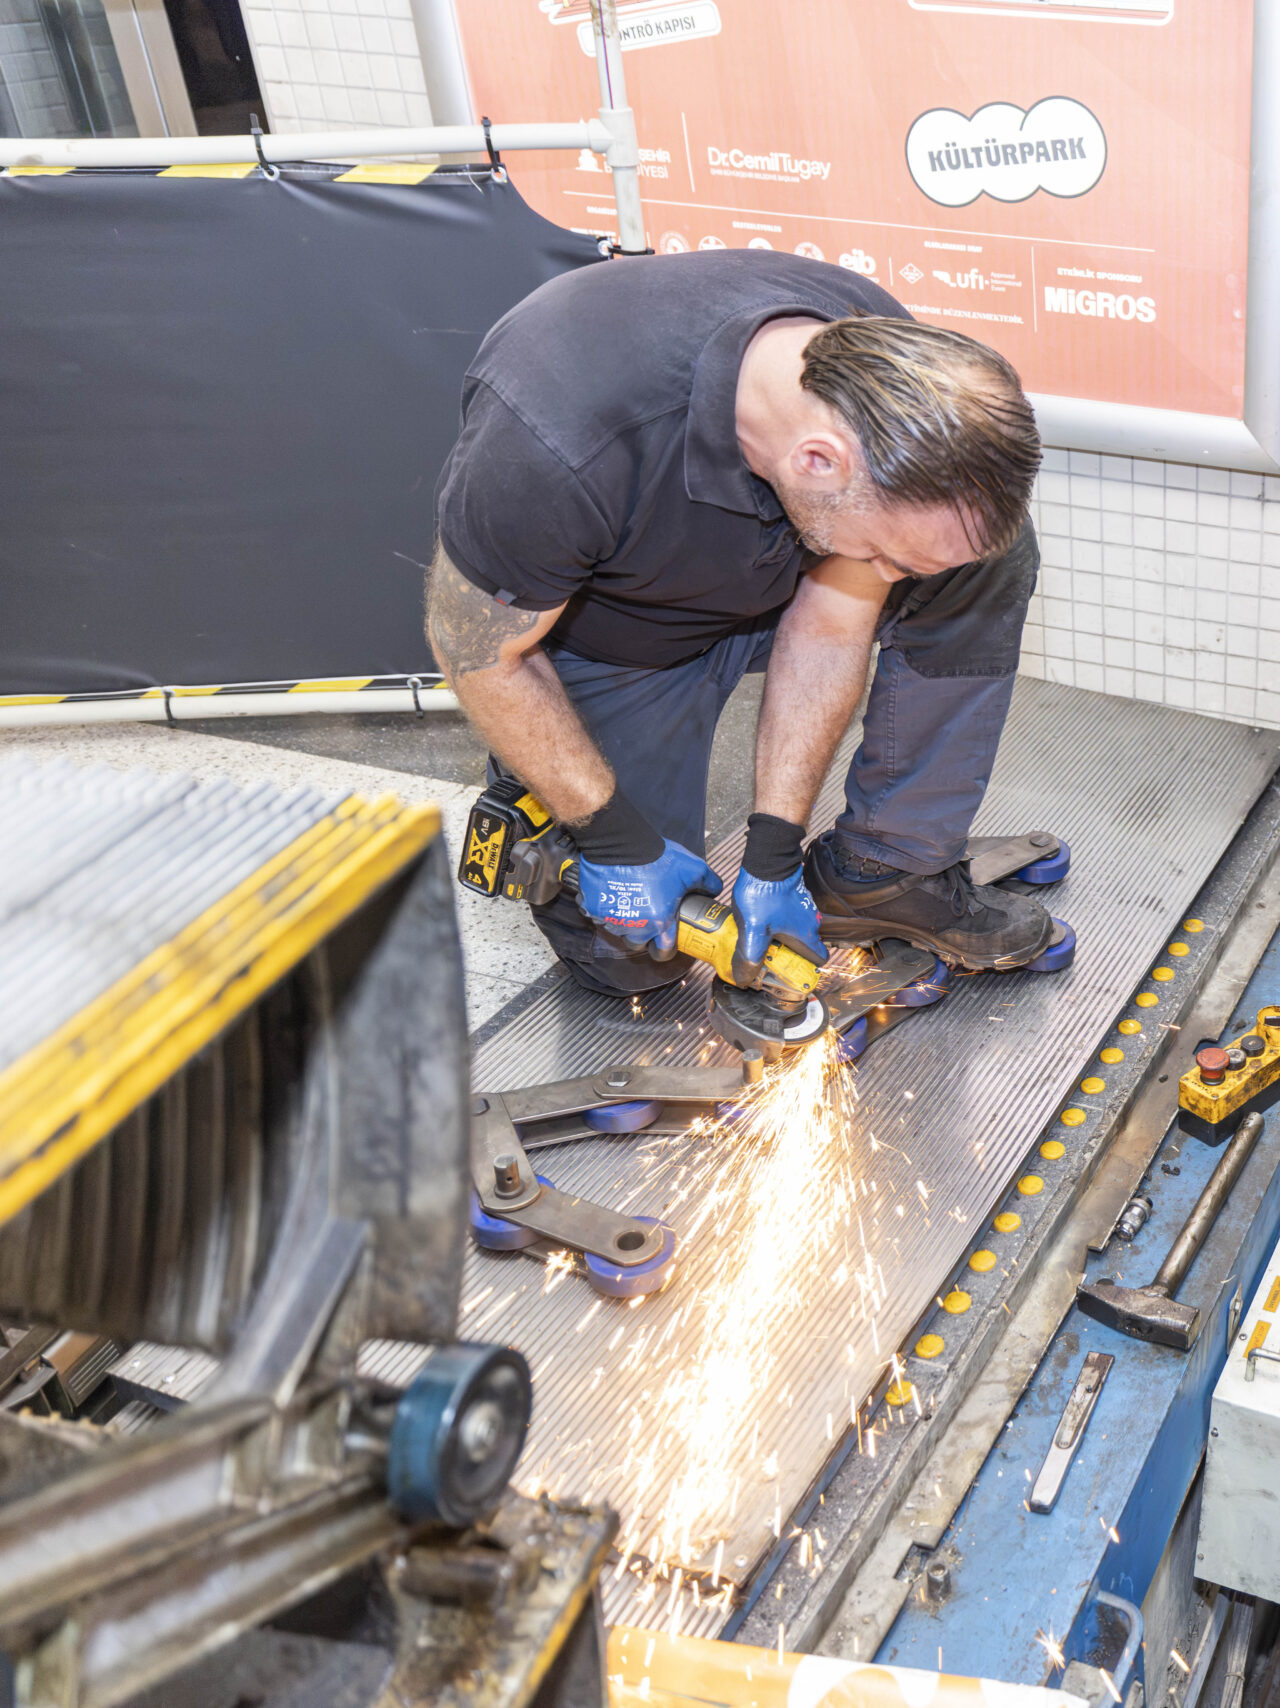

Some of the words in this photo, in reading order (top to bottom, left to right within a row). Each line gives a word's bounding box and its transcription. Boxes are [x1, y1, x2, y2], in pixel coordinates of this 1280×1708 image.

[619, 20, 653, 41] NTRÖ
[656, 16, 696, 35] KAPISI
[928, 137, 1086, 172] KÜLTÜRPARK
[600, 892, 616, 904] CE
[609, 908, 640, 918] NMF+
[604, 916, 648, 928] Beybi
